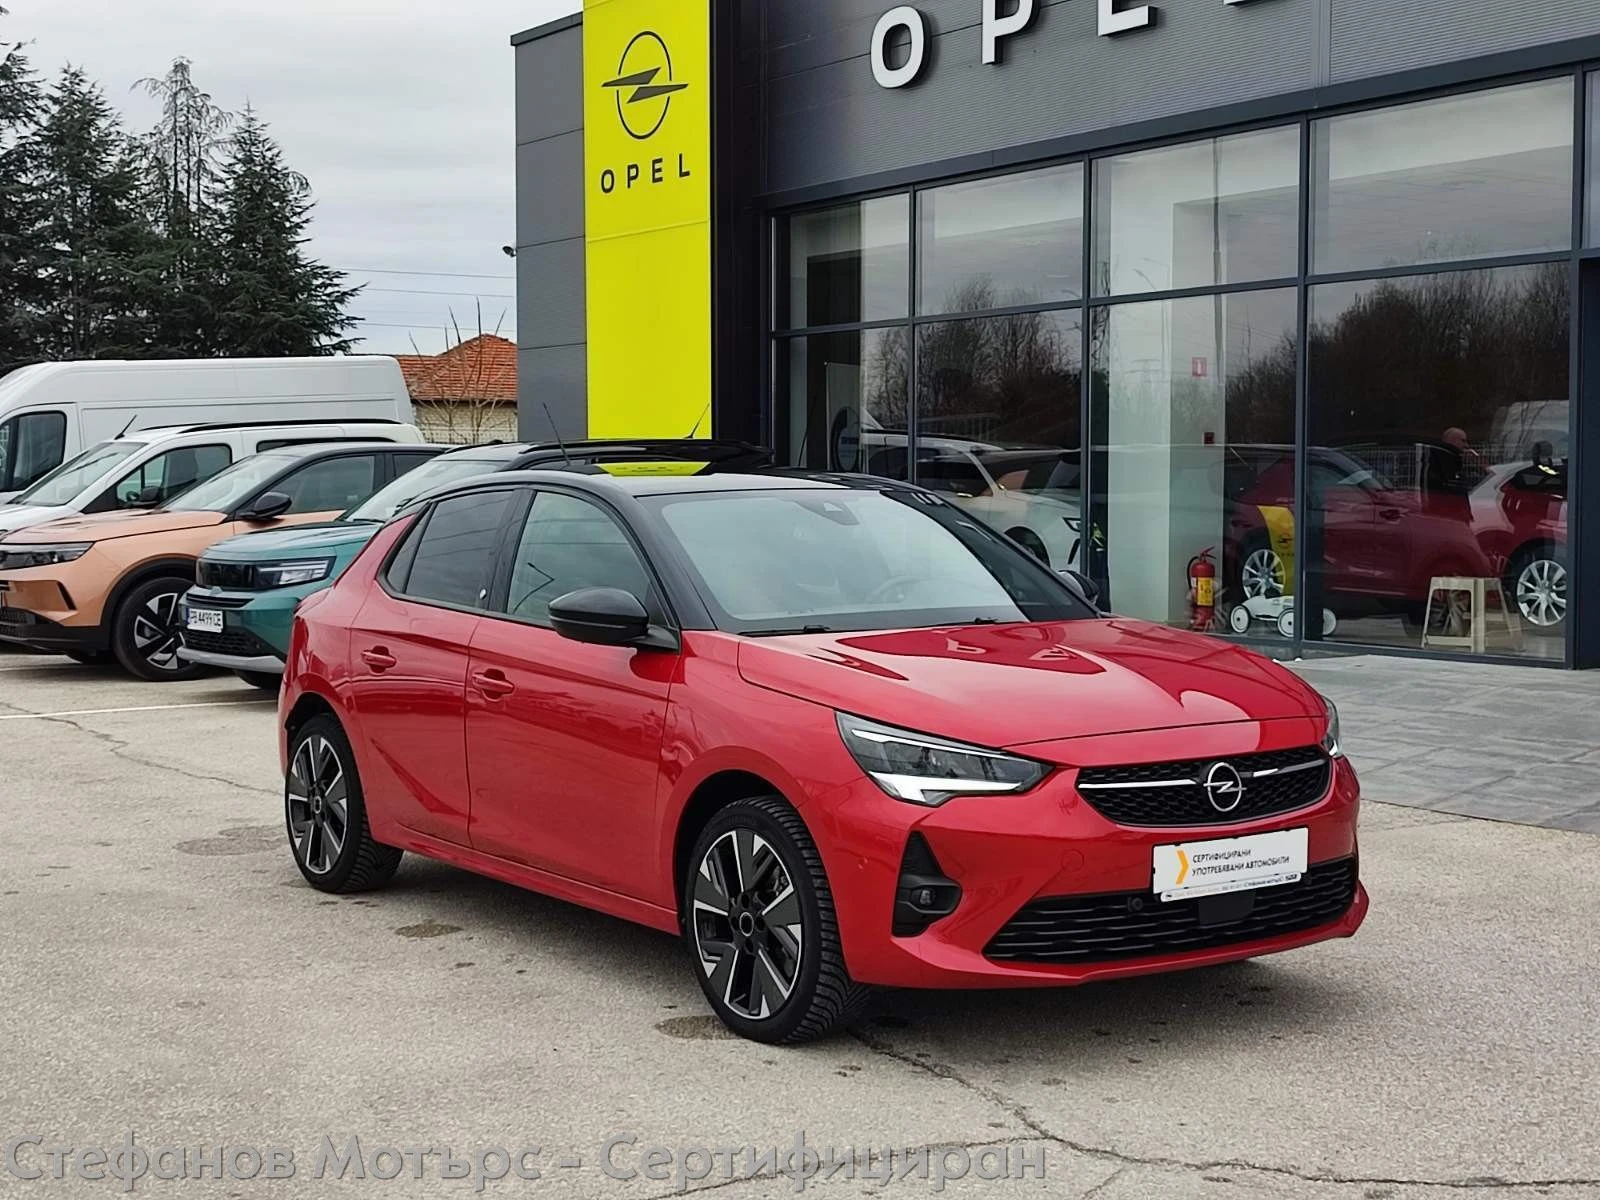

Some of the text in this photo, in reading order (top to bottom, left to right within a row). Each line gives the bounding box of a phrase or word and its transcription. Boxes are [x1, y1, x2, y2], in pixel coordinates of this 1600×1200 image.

[601, 153, 690, 194] OPEL
[1192, 849, 1252, 864] СЕРТИФИЦИРАНИ
[1192, 856, 1290, 877] УПОТРЕБЯВАНИ АВТОМОБИЛИ
